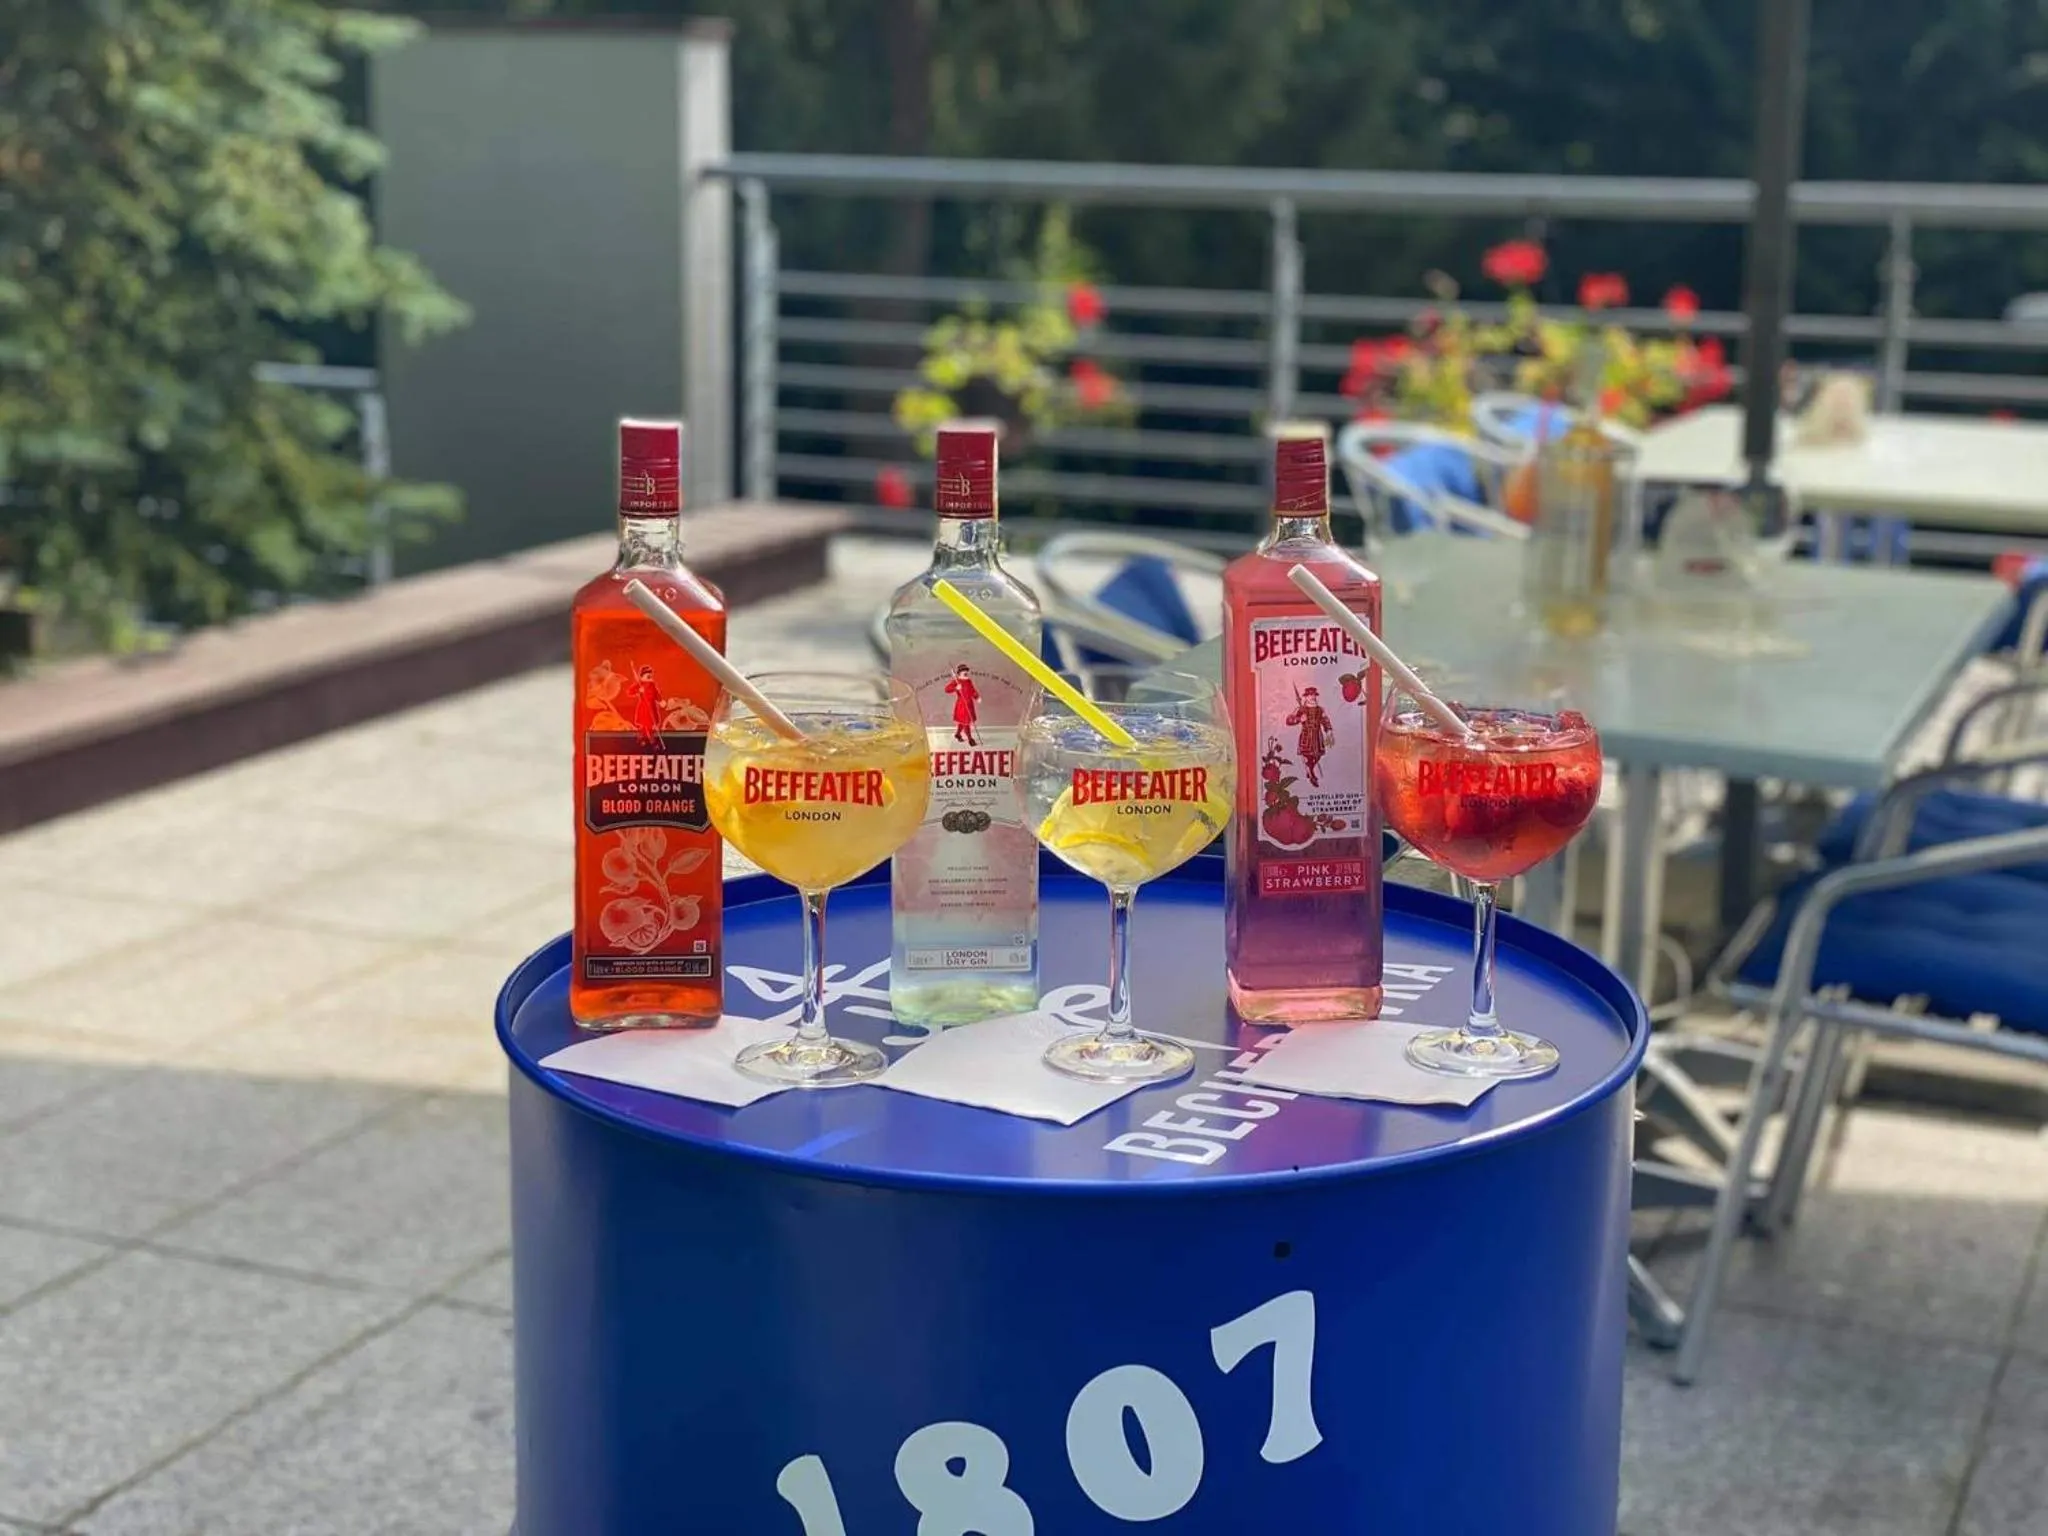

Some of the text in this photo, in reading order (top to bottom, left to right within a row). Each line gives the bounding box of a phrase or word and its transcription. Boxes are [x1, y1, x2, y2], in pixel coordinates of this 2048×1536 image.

[1284, 656, 1338, 666] LONDON
[618, 783, 682, 793] LONDON
[744, 766, 884, 807] BEEFEATER
[936, 779, 997, 789] LONDON
[1072, 766, 1208, 807] BEEFEATER
[602, 799, 696, 814] BLOOD ORANGE
[1117, 804, 1171, 815] LONDON
[785, 811, 841, 821] LONDON
[1298, 864, 1330, 876] PINK
[1266, 875, 1361, 889] STRAWBERRY
